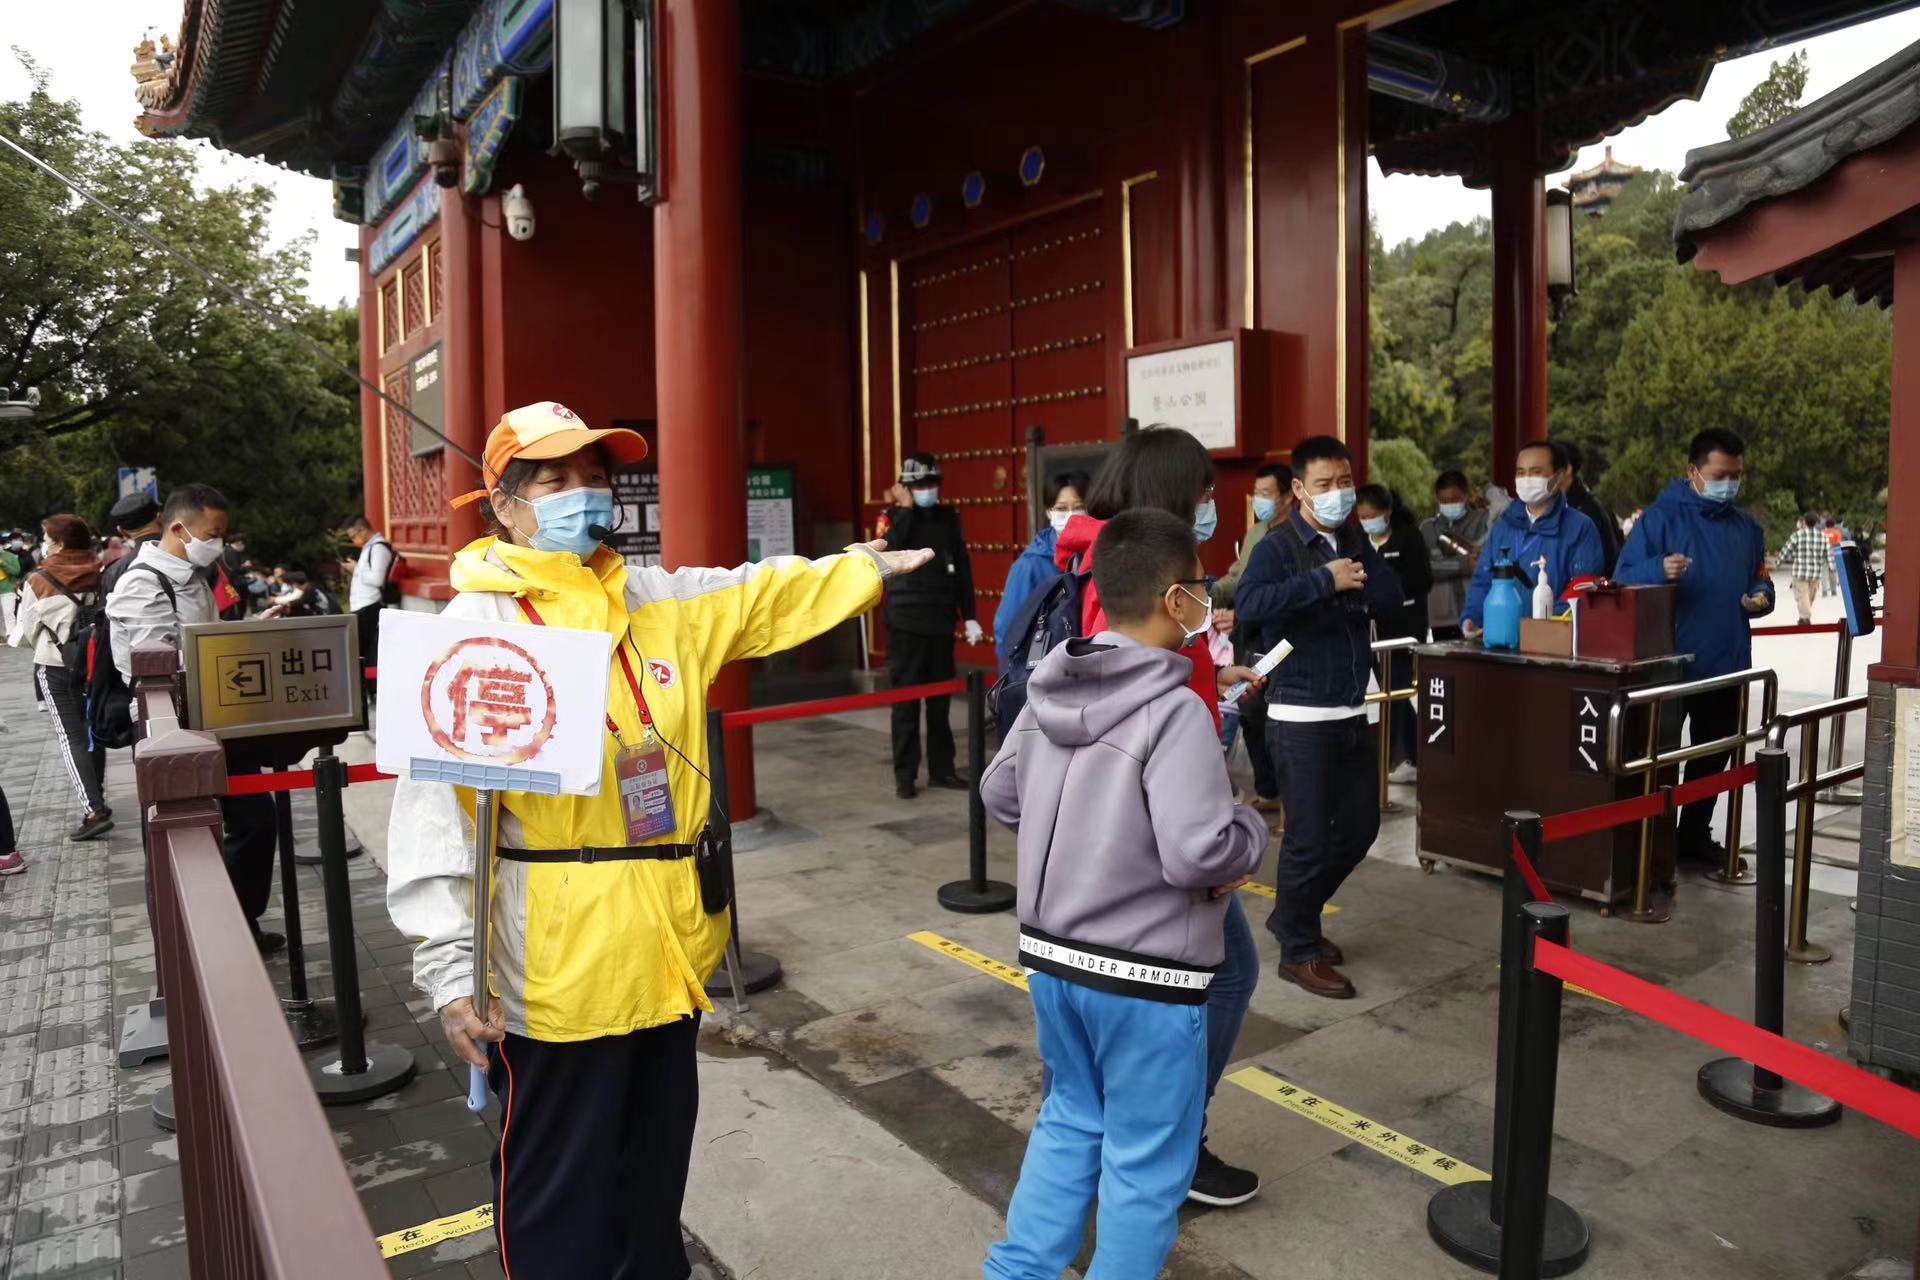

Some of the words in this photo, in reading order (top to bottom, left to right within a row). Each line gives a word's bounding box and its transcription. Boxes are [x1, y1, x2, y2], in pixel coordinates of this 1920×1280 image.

[747, 474, 771, 486] 公园
[282, 648, 332, 675] 出口
[285, 684, 328, 703] Exit
[447, 666, 532, 745] 停
[1429, 677, 1445, 721] 出口
[1580, 696, 1599, 744] 入口
[1068, 951, 1118, 974] UNDER
[1127, 966, 1190, 986] ARMOUR
[1276, 1085, 1458, 1171] 请在一米外等候
[1314, 1113, 1337, 1126] wait
[1335, 1124, 1357, 1135] one
[1388, 1149, 1420, 1166] away
[380, 1206, 493, 1250] 在一米
[393, 1234, 440, 1252] Please
[442, 1225, 471, 1237] wait
[474, 1217, 494, 1227] on
